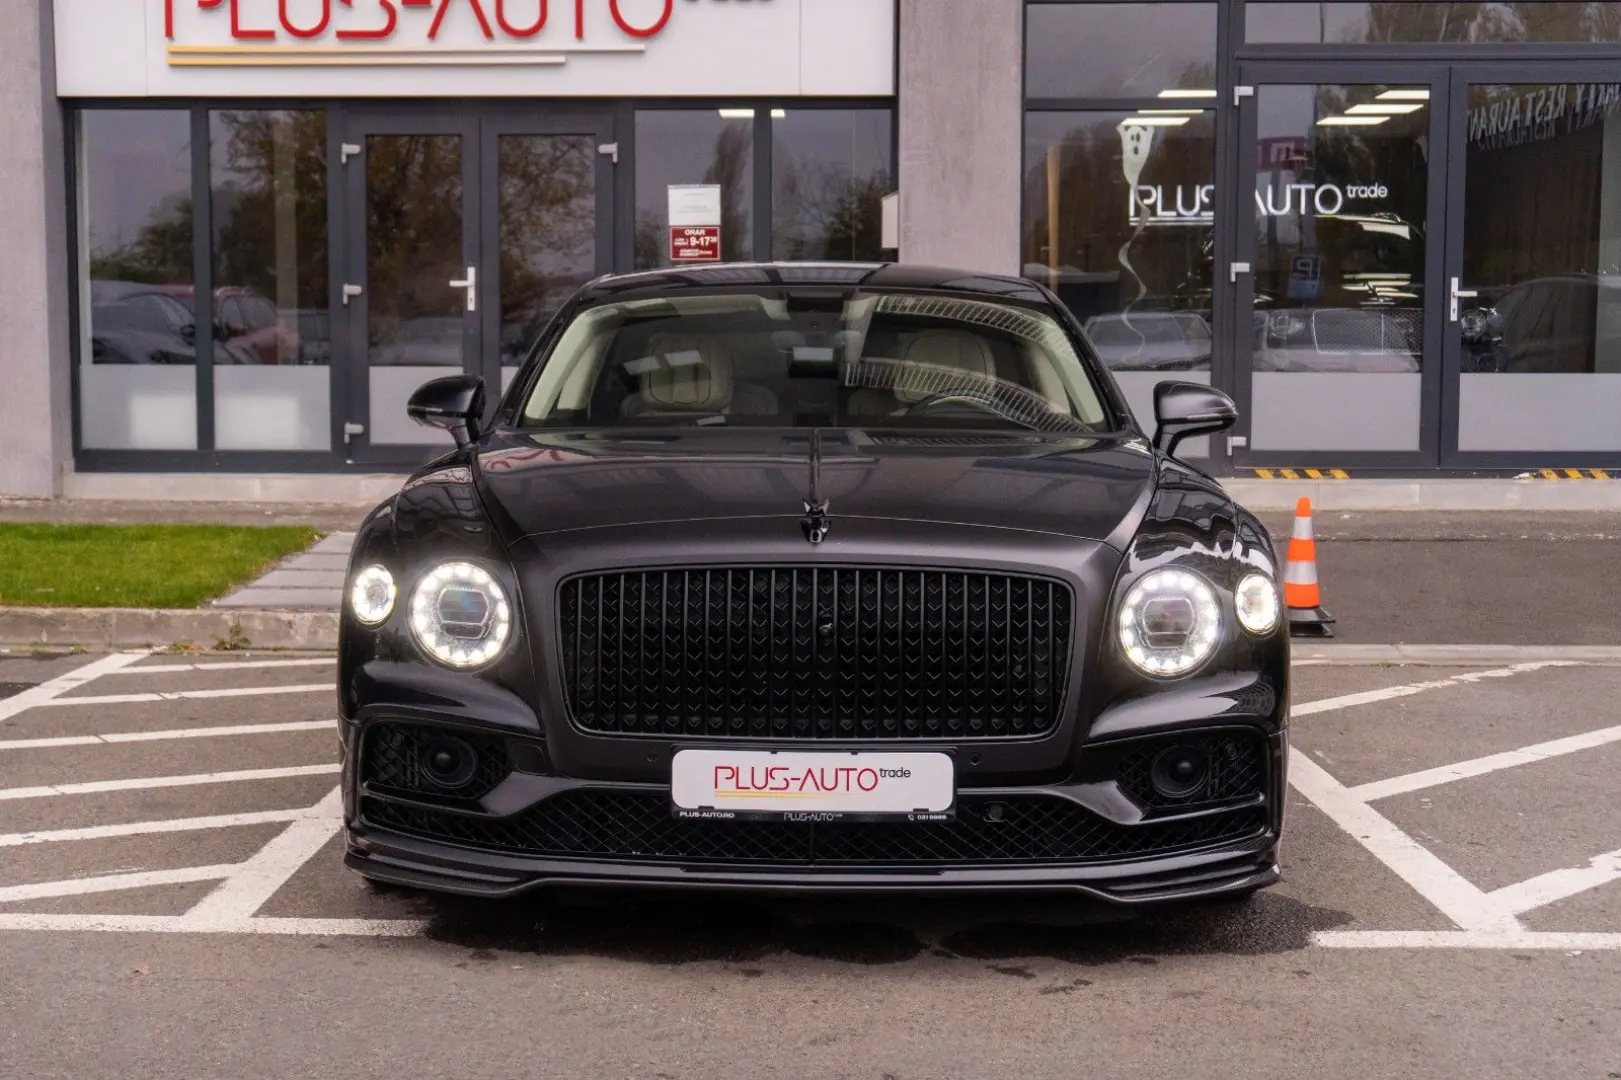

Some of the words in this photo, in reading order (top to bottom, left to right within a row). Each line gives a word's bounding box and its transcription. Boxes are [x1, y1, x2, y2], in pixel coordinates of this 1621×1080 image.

[1347, 184, 1388, 198] trade
[714, 766, 879, 792] PLUS-AUTO
[879, 767, 911, 778] trade
